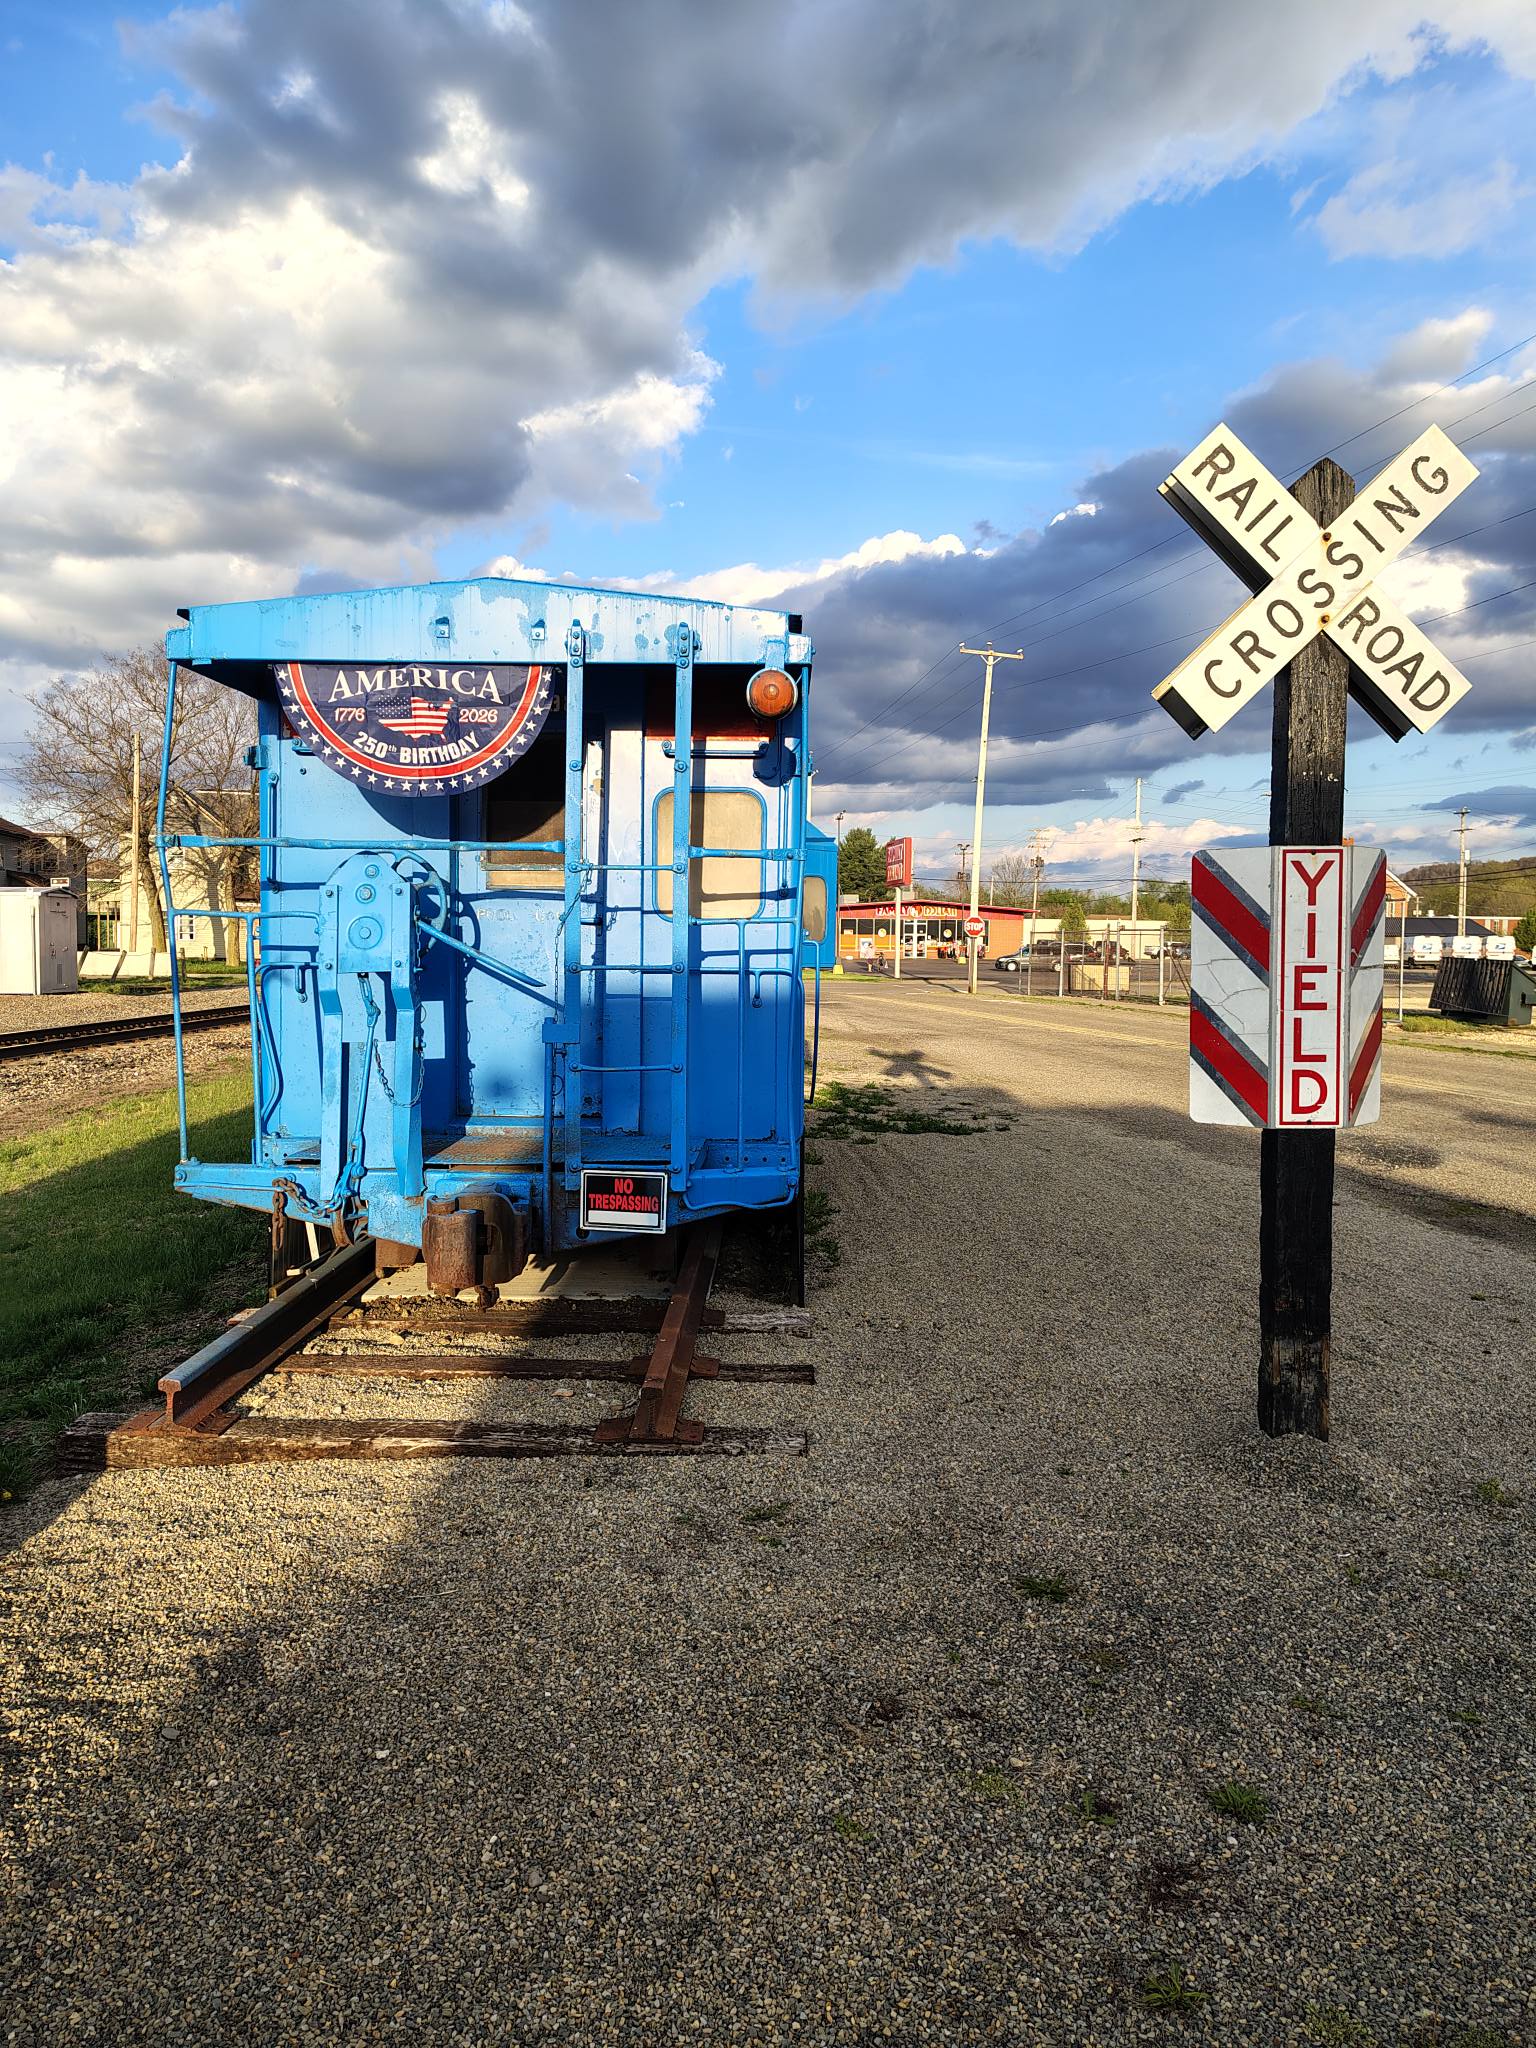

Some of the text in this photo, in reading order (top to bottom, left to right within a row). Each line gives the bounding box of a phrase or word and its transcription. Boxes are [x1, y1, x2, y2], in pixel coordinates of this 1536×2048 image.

[1191, 443, 1293, 562] RAIL
[1204, 455, 1449, 698] CROSSING
[1338, 596, 1451, 711] ROAD
[328, 666, 504, 704] AMERICA
[334, 707, 365, 722] 1776
[459, 708, 498, 723] 2026
[353, 731, 480, 764] 250th BIRTHDAY
[876, 905, 909, 916] FAMLY
[966, 922, 984, 931] STOP
[1290, 860, 1335, 1115] YIELD
[614, 1178, 634, 1194] NO
[588, 1193, 659, 1212] TRESPASSING
